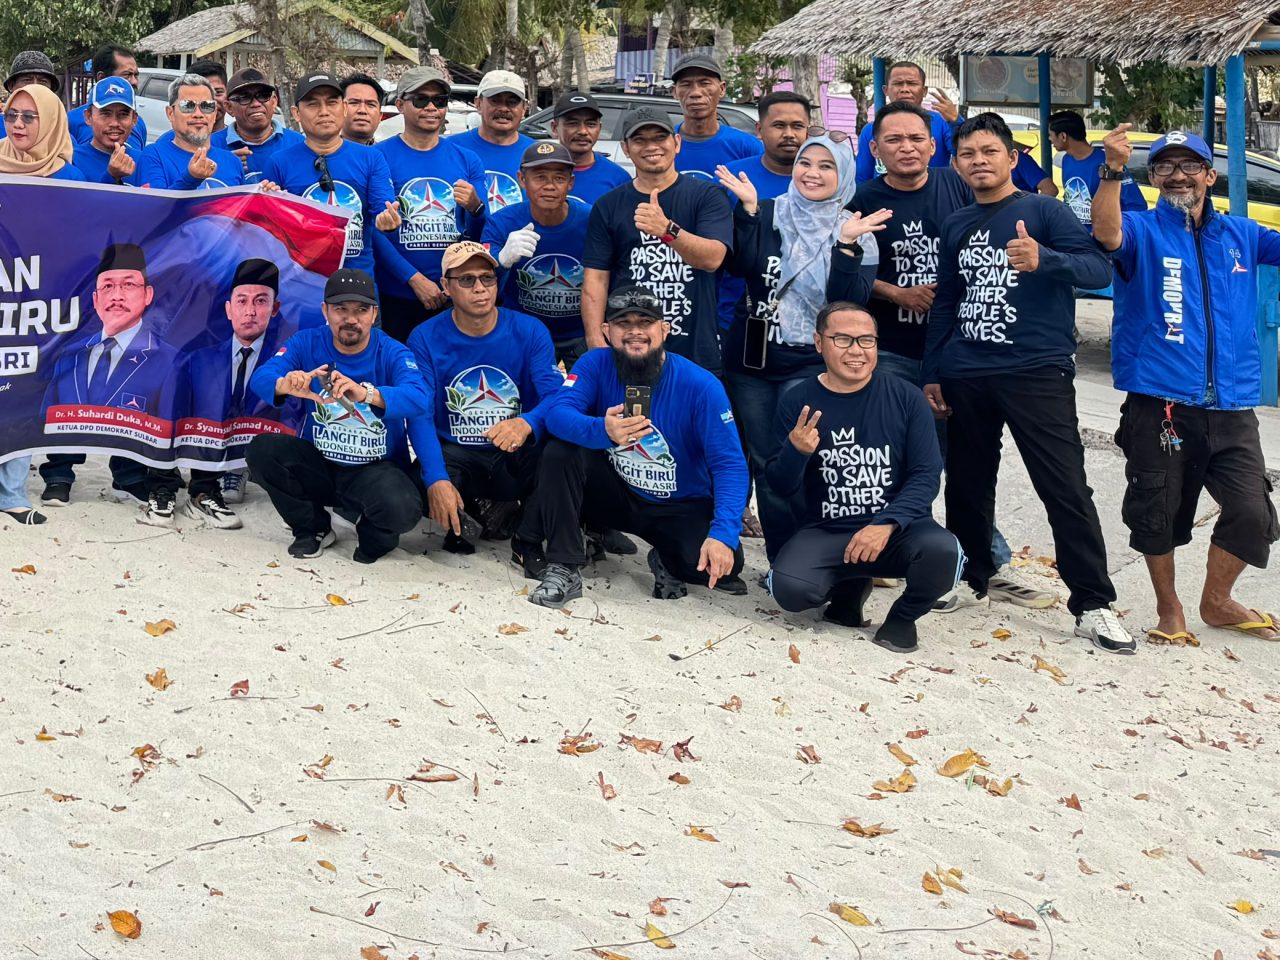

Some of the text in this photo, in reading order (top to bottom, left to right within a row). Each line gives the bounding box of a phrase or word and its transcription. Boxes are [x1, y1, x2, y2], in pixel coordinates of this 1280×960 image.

[400, 223, 441, 234] LANGIT
[400, 233, 447, 242] INDONESIA
[891, 235, 940, 256] PASSIO
[891, 256, 910, 273] TO
[959, 245, 1008, 268] PASSIO
[629, 263, 694, 282] TO SAVE
[975, 267, 1019, 287] SAVE
[636, 281, 685, 299] THER
[958, 303, 1017, 323] PEOPLE'S
[77, 409, 114, 420] Suhardi
[116, 412, 143, 426] Duka,
[144, 420, 163, 432] M.M.
[232, 421, 262, 430] Samad
[450, 415, 497, 427] LANGIT
[95, 425, 132, 436] DEMOKRAT
[134, 431, 158, 445] SULBAR
[181, 436, 203, 444] KETUA
[205, 438, 220, 447] DPC
[314, 427, 385, 448] LANGIT BIRU
[315, 440, 385, 455] INDONESIA ASRI
[818, 444, 890, 467] PASSION
[646, 469, 675, 482] BIRU
[818, 466, 892, 487] TO SAVE
[652, 482, 675, 490] ASRI
[828, 486, 885, 505] OTHER
